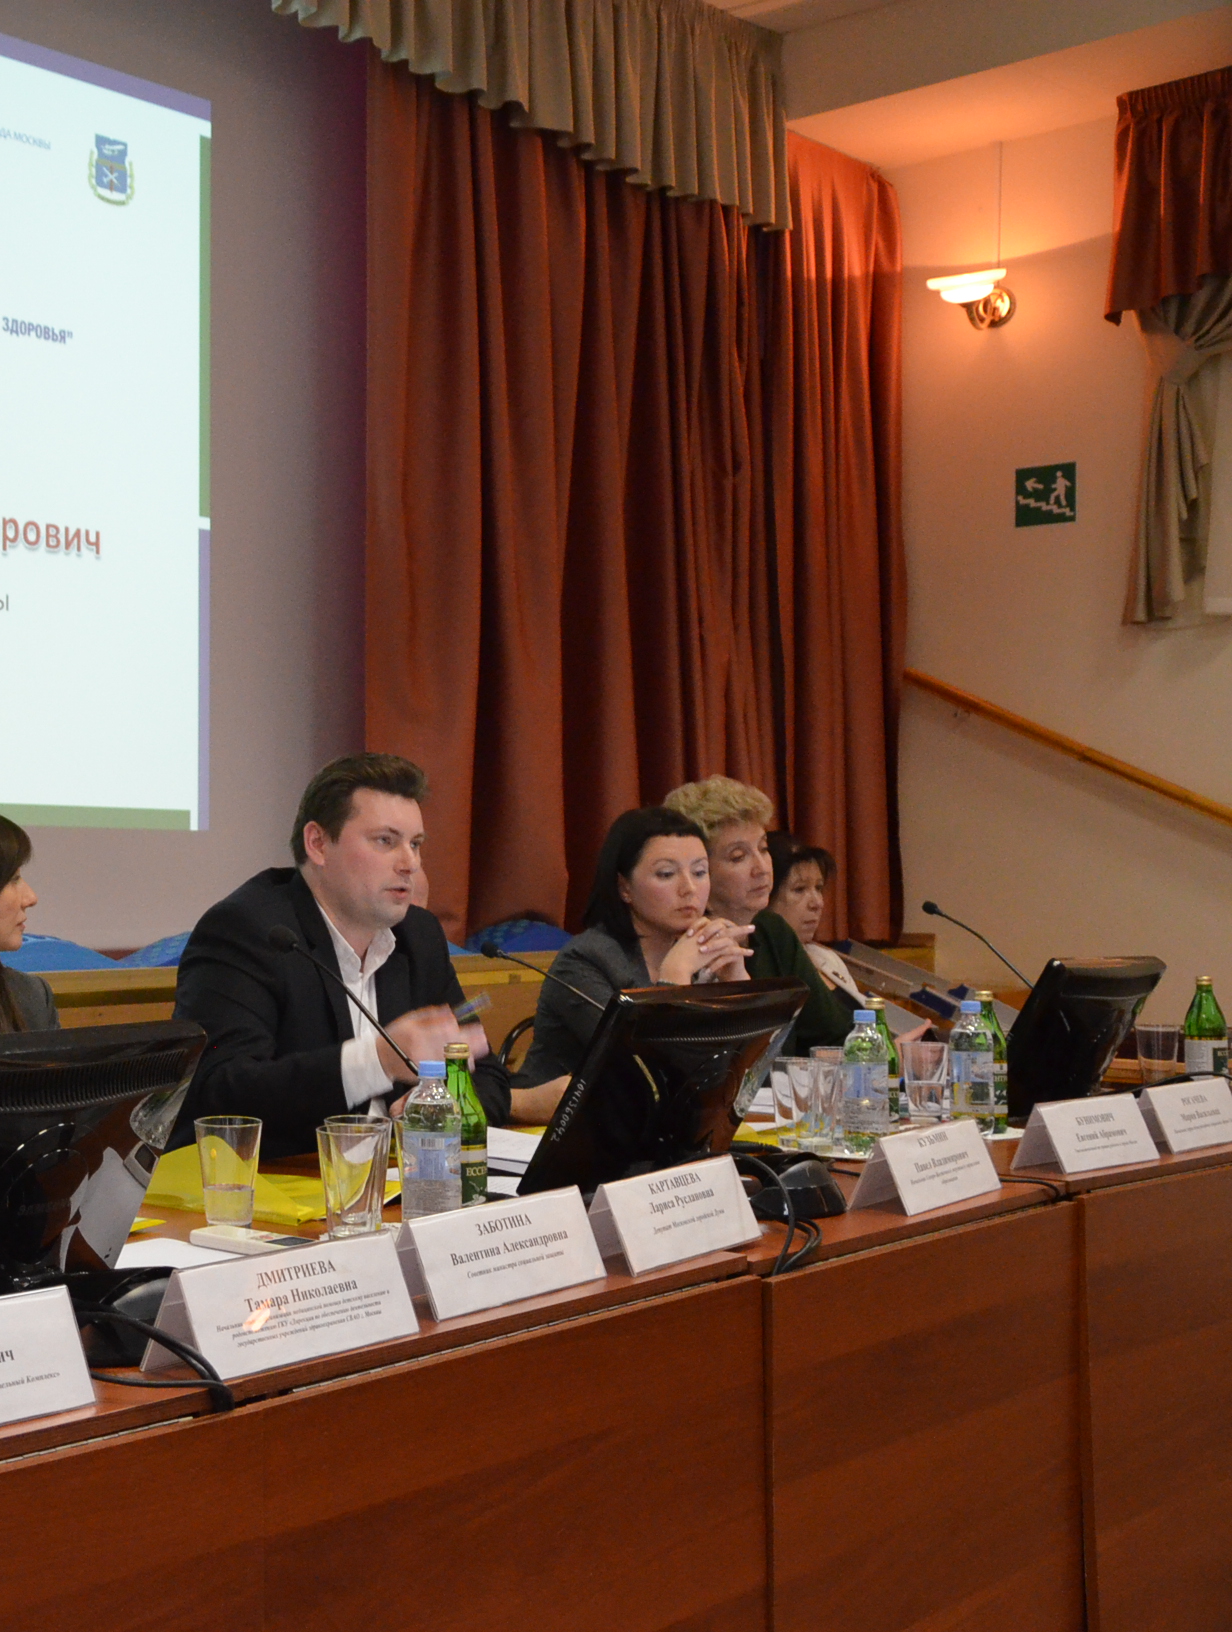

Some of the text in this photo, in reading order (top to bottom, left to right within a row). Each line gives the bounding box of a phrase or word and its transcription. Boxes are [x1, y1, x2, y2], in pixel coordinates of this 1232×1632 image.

[13, 131, 51, 150] МОСКВЫ
[648, 1172, 702, 1195] КАРТАВЦЕВА
[648, 1188, 715, 1215] Лариса Руслановна
[475, 1213, 533, 1237] ЗАБОТИНА
[450, 1229, 569, 1267] Валентина Александровна
[255, 1259, 337, 1290] ДМИТРИЕВА
[243, 1278, 359, 1313] Тамара Николаевна
